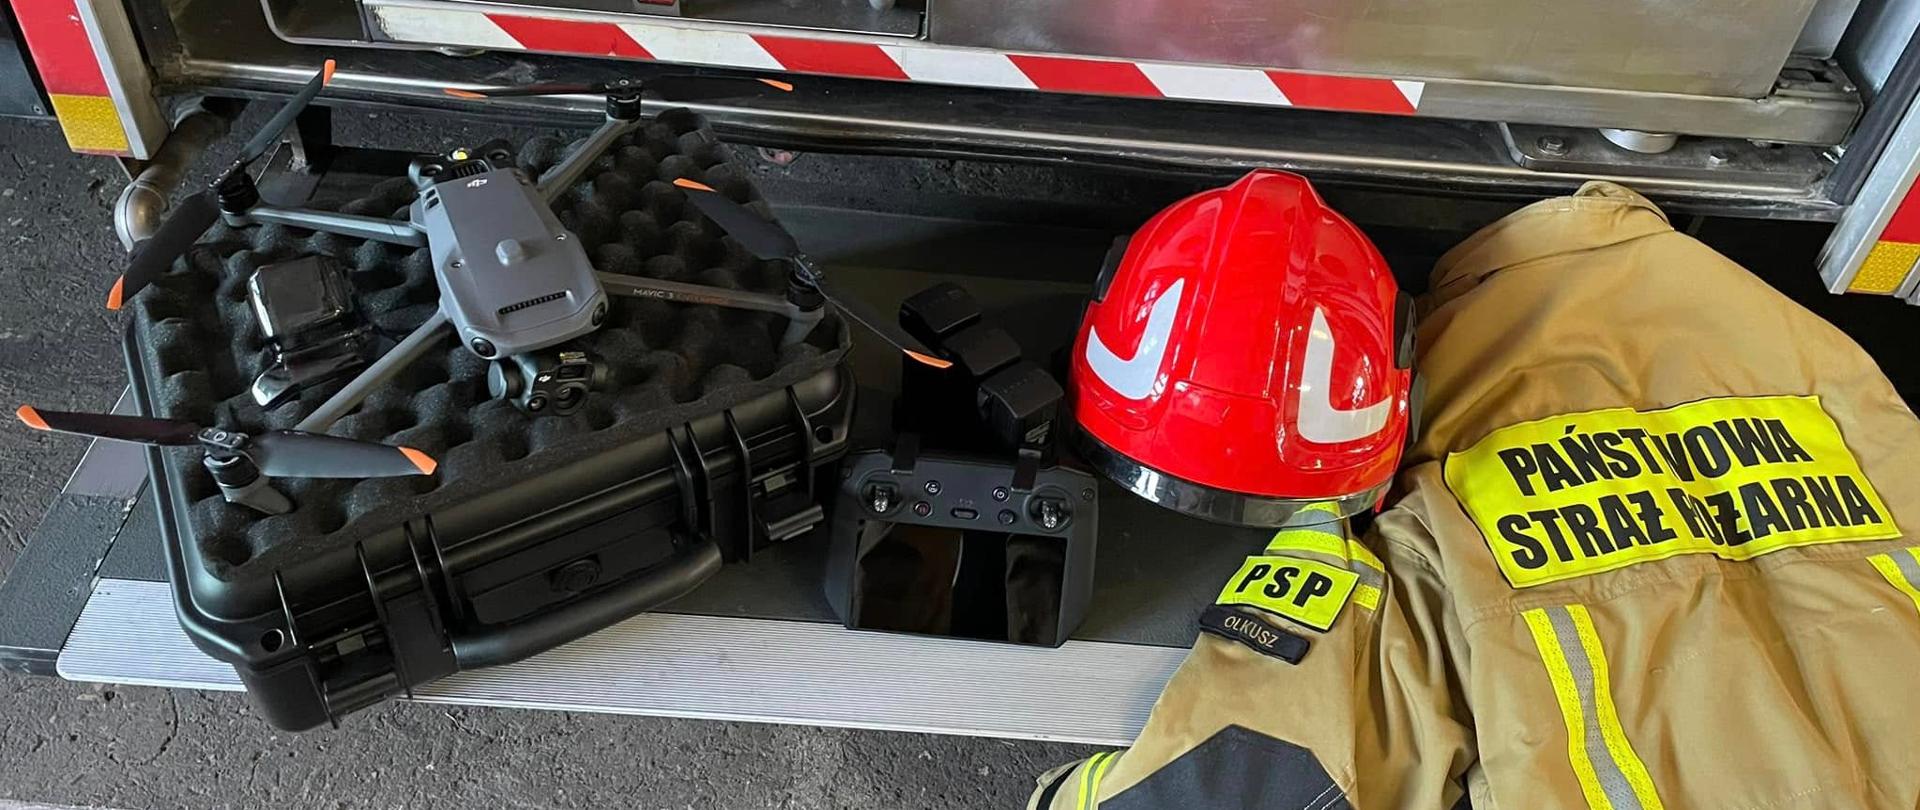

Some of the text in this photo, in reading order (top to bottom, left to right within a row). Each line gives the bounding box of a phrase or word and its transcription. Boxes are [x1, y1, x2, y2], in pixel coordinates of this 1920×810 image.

[633, 288, 665, 298] MAVIC
[1235, 564, 1333, 608] PSP
[1224, 616, 1280, 648] OLKUSZ
